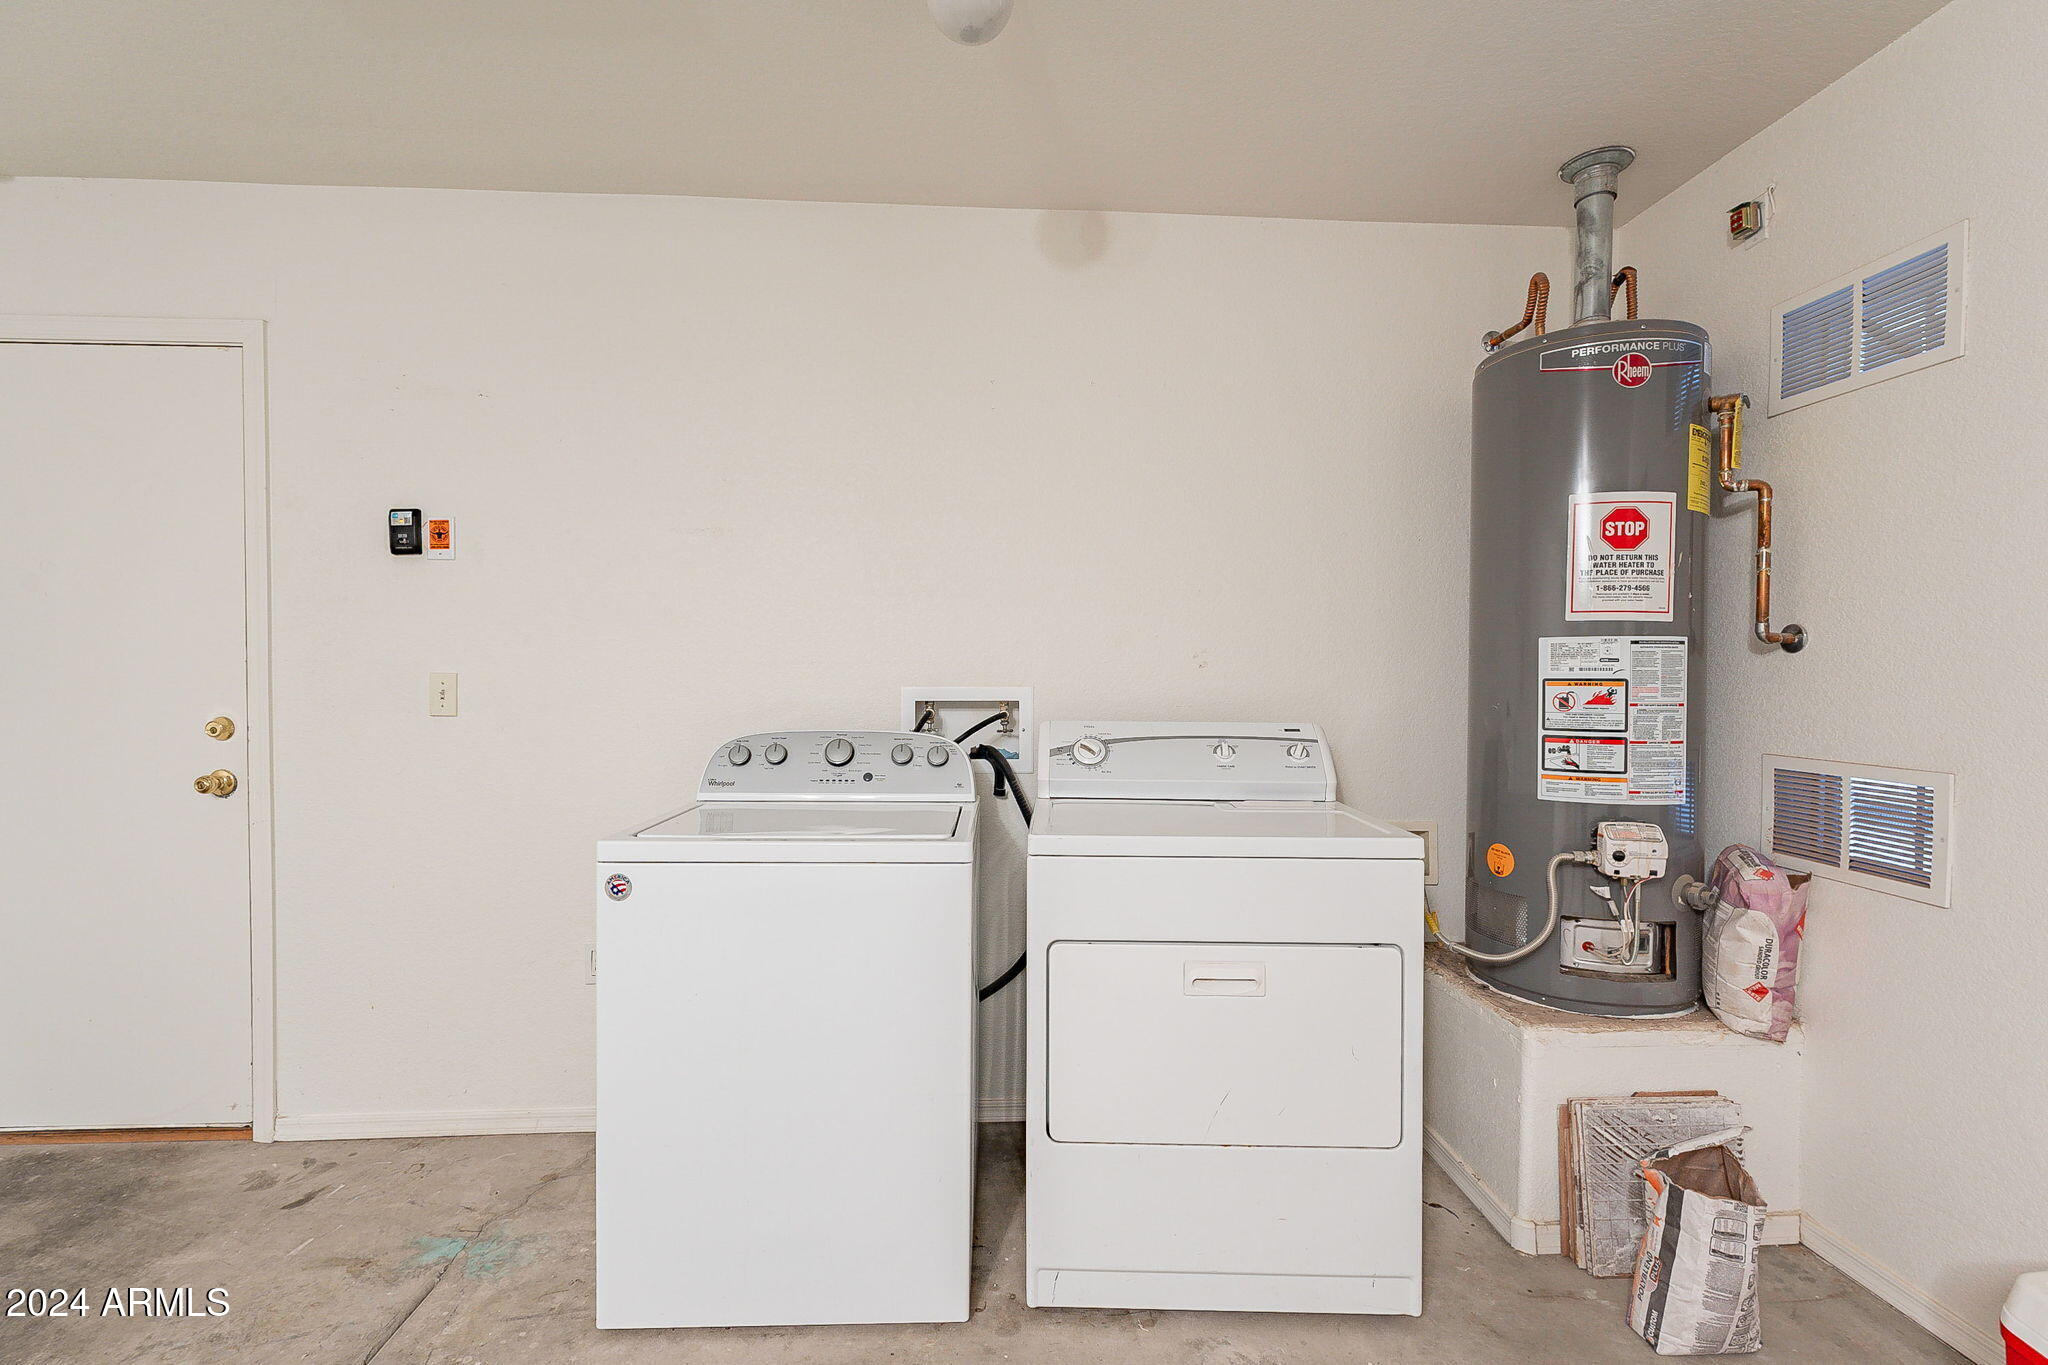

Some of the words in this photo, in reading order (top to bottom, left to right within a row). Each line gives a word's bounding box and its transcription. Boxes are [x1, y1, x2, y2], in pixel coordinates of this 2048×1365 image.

[1571, 341, 1660, 358] PERFORMANCE
[1617, 353, 1649, 383] Rheem
[1604, 521, 1646, 537] STOP
[1631, 569, 1664, 577] PURCHASE
[1759, 938, 1774, 980] DURACOLOR
[1637, 1250, 1653, 1302] POLYBLEND
[1647, 1309, 1659, 1337] CUSTOM
